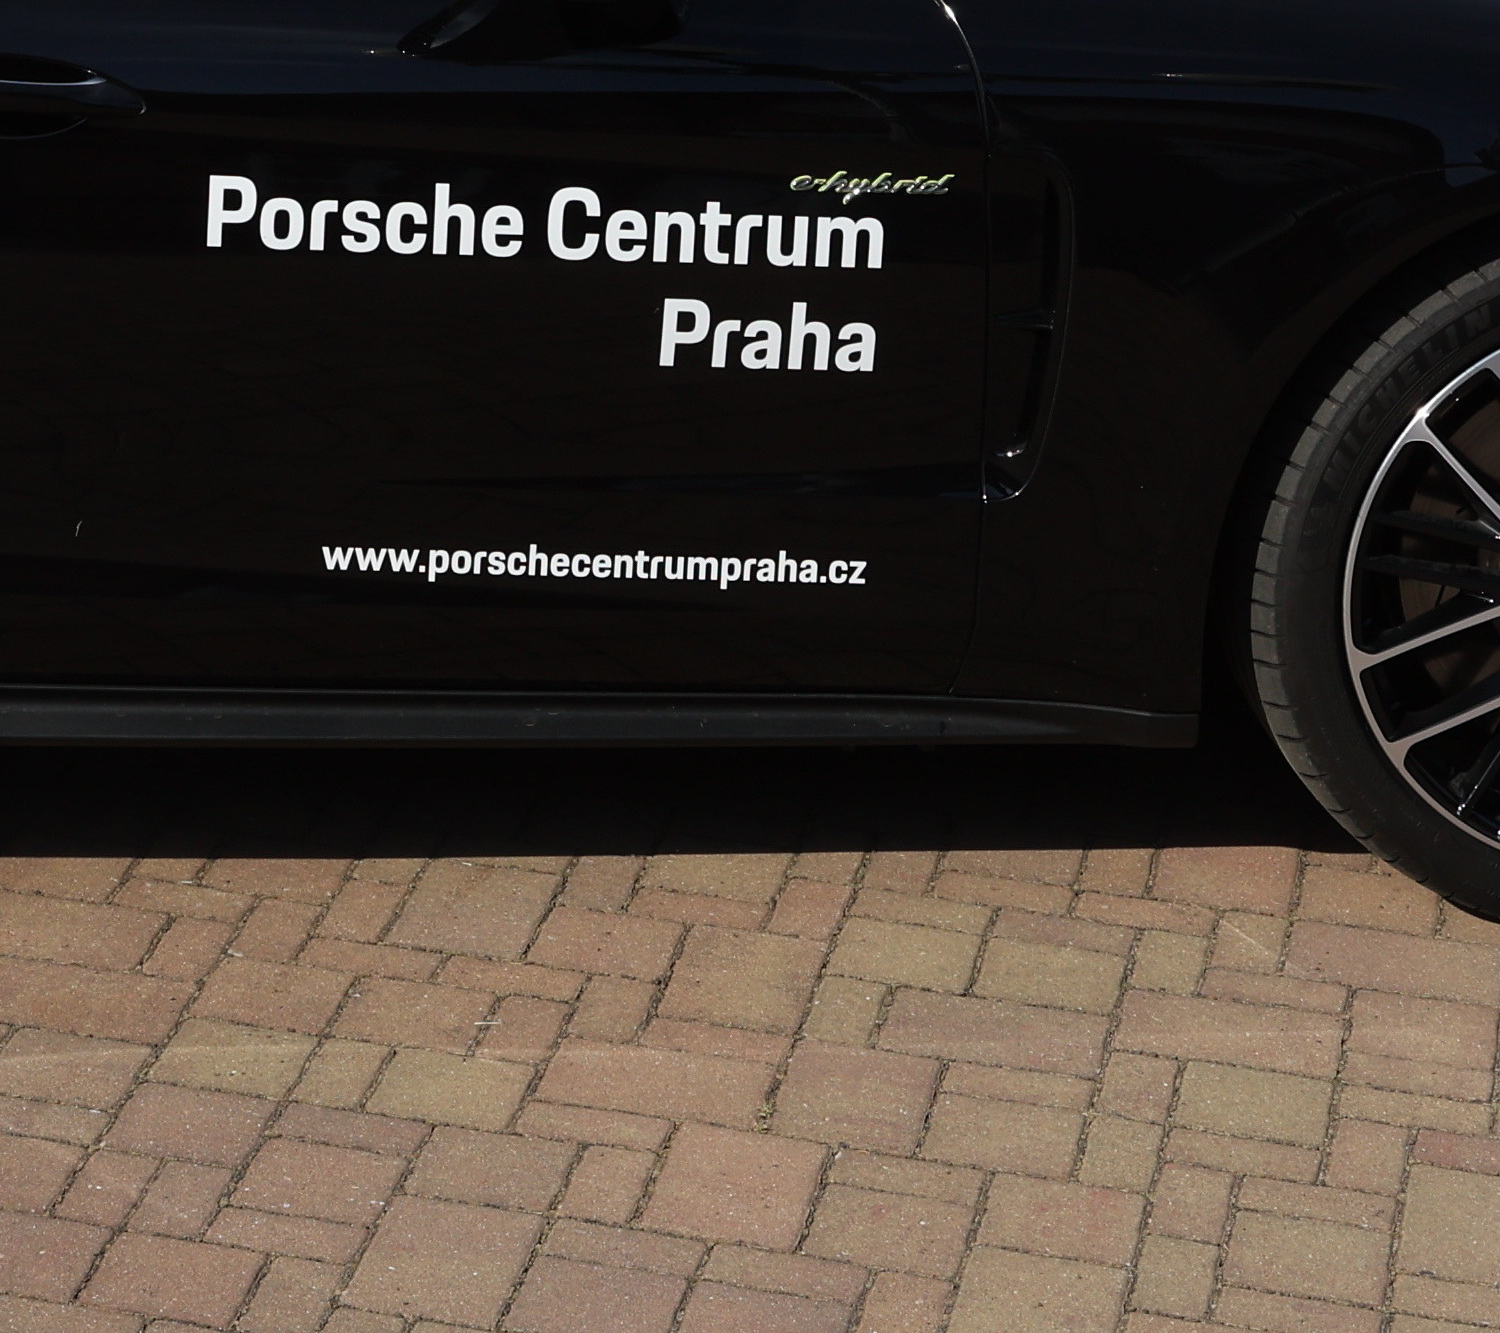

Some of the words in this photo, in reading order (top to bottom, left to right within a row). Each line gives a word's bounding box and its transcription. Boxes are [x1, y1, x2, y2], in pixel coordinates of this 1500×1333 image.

[206, 174, 524, 257] Porsche
[547, 187, 884, 269] Centrum
[658, 297, 876, 373] Praha
[322, 542, 867, 590] www.porschecentrumpraha.cz
